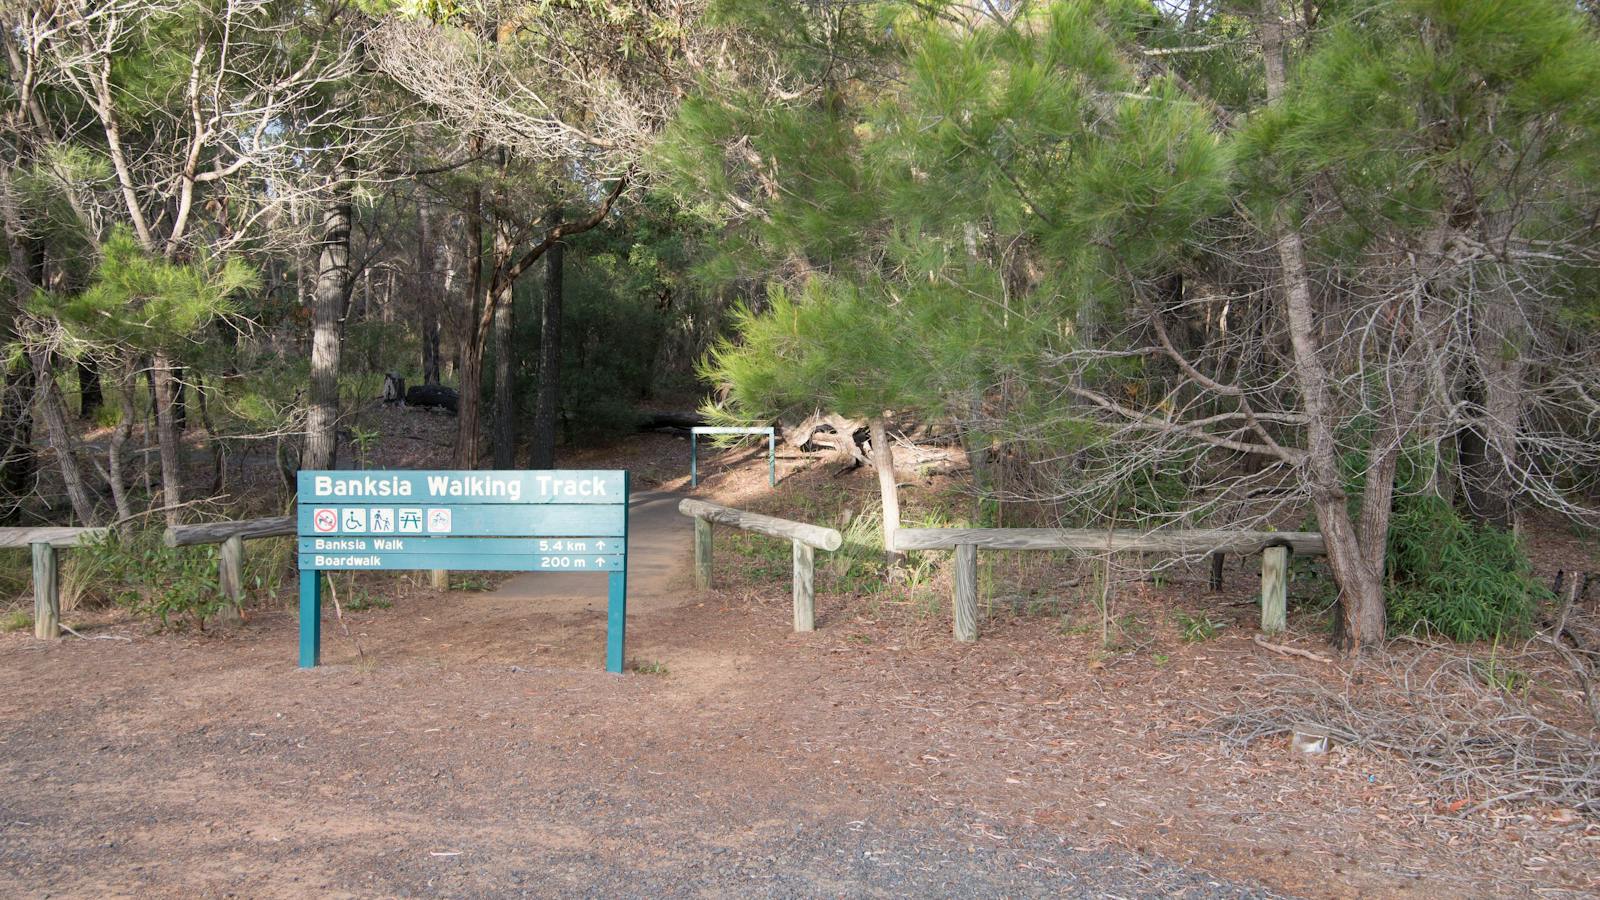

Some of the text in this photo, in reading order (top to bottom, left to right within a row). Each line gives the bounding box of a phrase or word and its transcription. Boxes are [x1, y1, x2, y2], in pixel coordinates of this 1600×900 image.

[315, 475, 607, 500] Banksia Walking Track
[315, 539, 586, 551] Banksia Walk 5.4 km
[315, 555, 586, 568] Boardwalk 200 m
